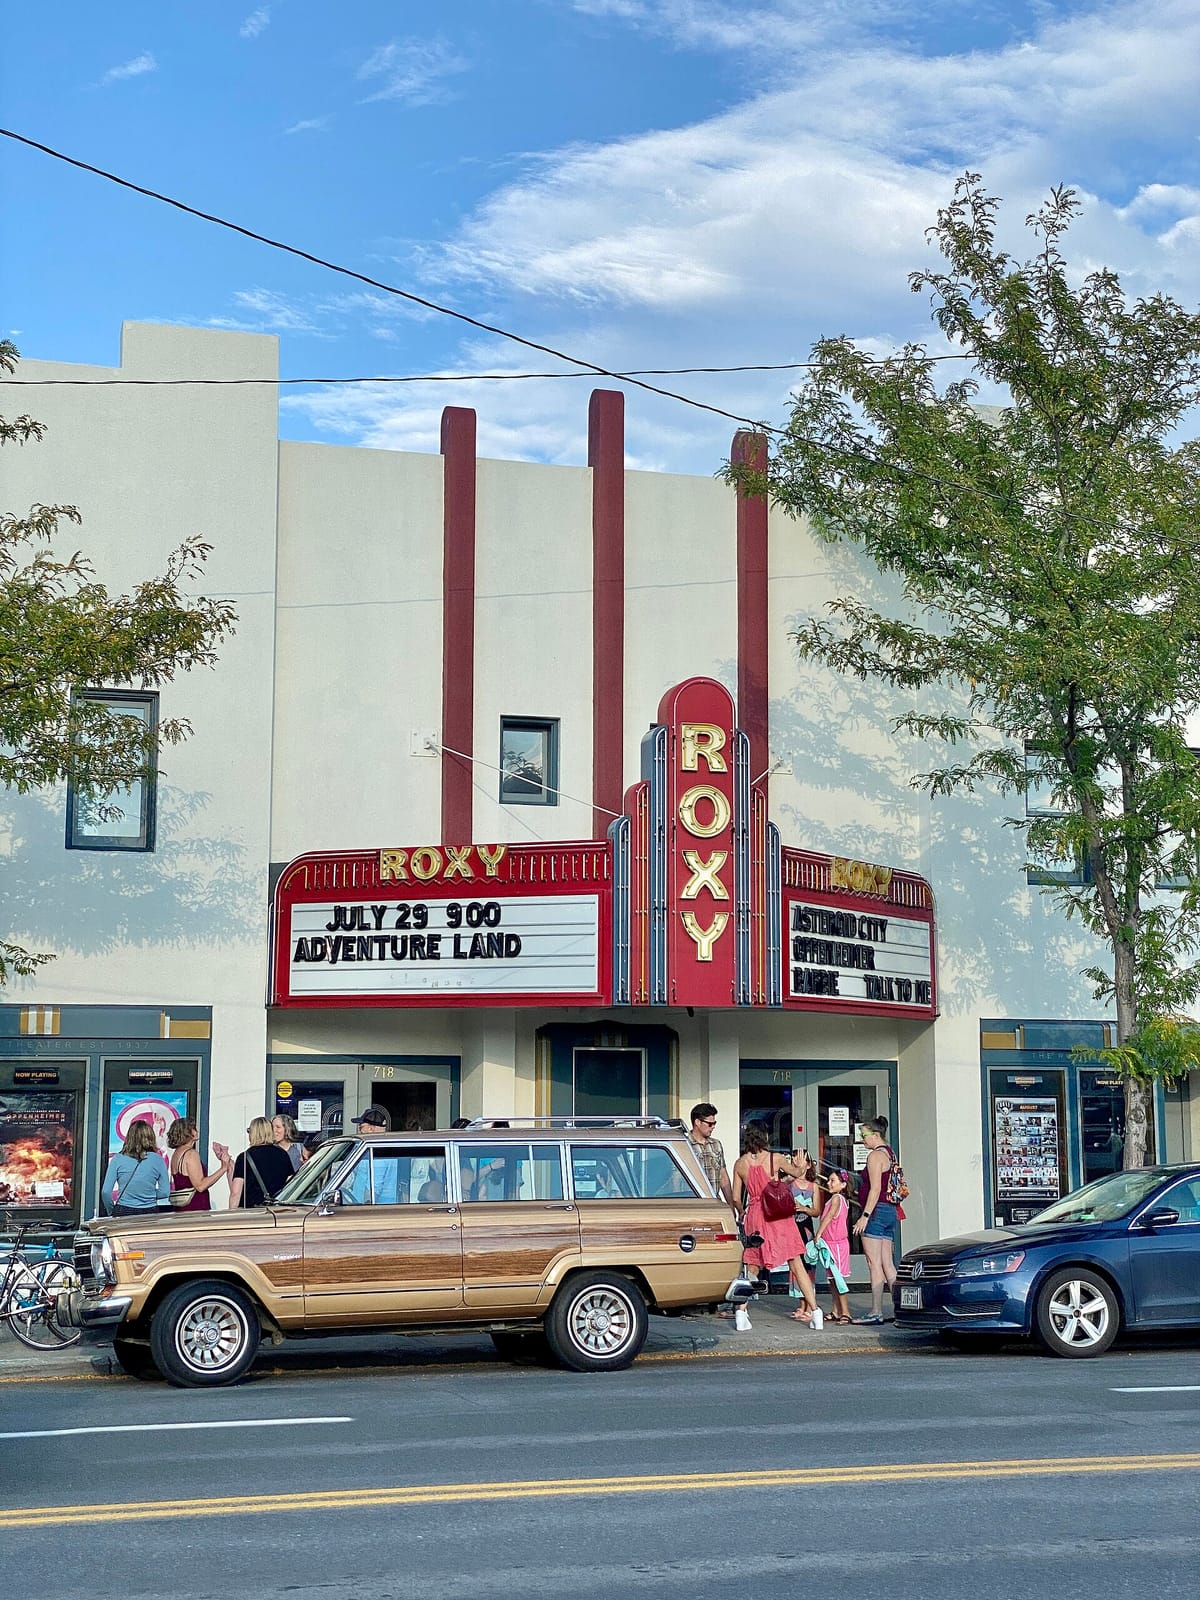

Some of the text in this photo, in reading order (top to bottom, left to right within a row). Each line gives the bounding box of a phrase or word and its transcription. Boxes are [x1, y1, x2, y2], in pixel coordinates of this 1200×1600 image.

[679, 723, 731, 962] ROXY
[380, 846, 507, 880] ROXY
[831, 857, 892, 895] ROXY
[325, 905, 387, 932] JULY
[395, 903, 429, 930] 29
[792, 905, 888, 943] ASTEROID CITY
[293, 932, 523, 964] ADVENTURE LAND
[793, 936, 876, 970] OPPENHEIMER
[793, 966, 931, 1005] BARBIE TALK TO ME
[7, 1040, 72, 1049] THEATER
[117, 1040, 150, 1050] 1937
[1031, 1052, 1052, 1060] THE
[374, 1066, 394, 1079] 718
[772, 1070, 792, 1082] 718
